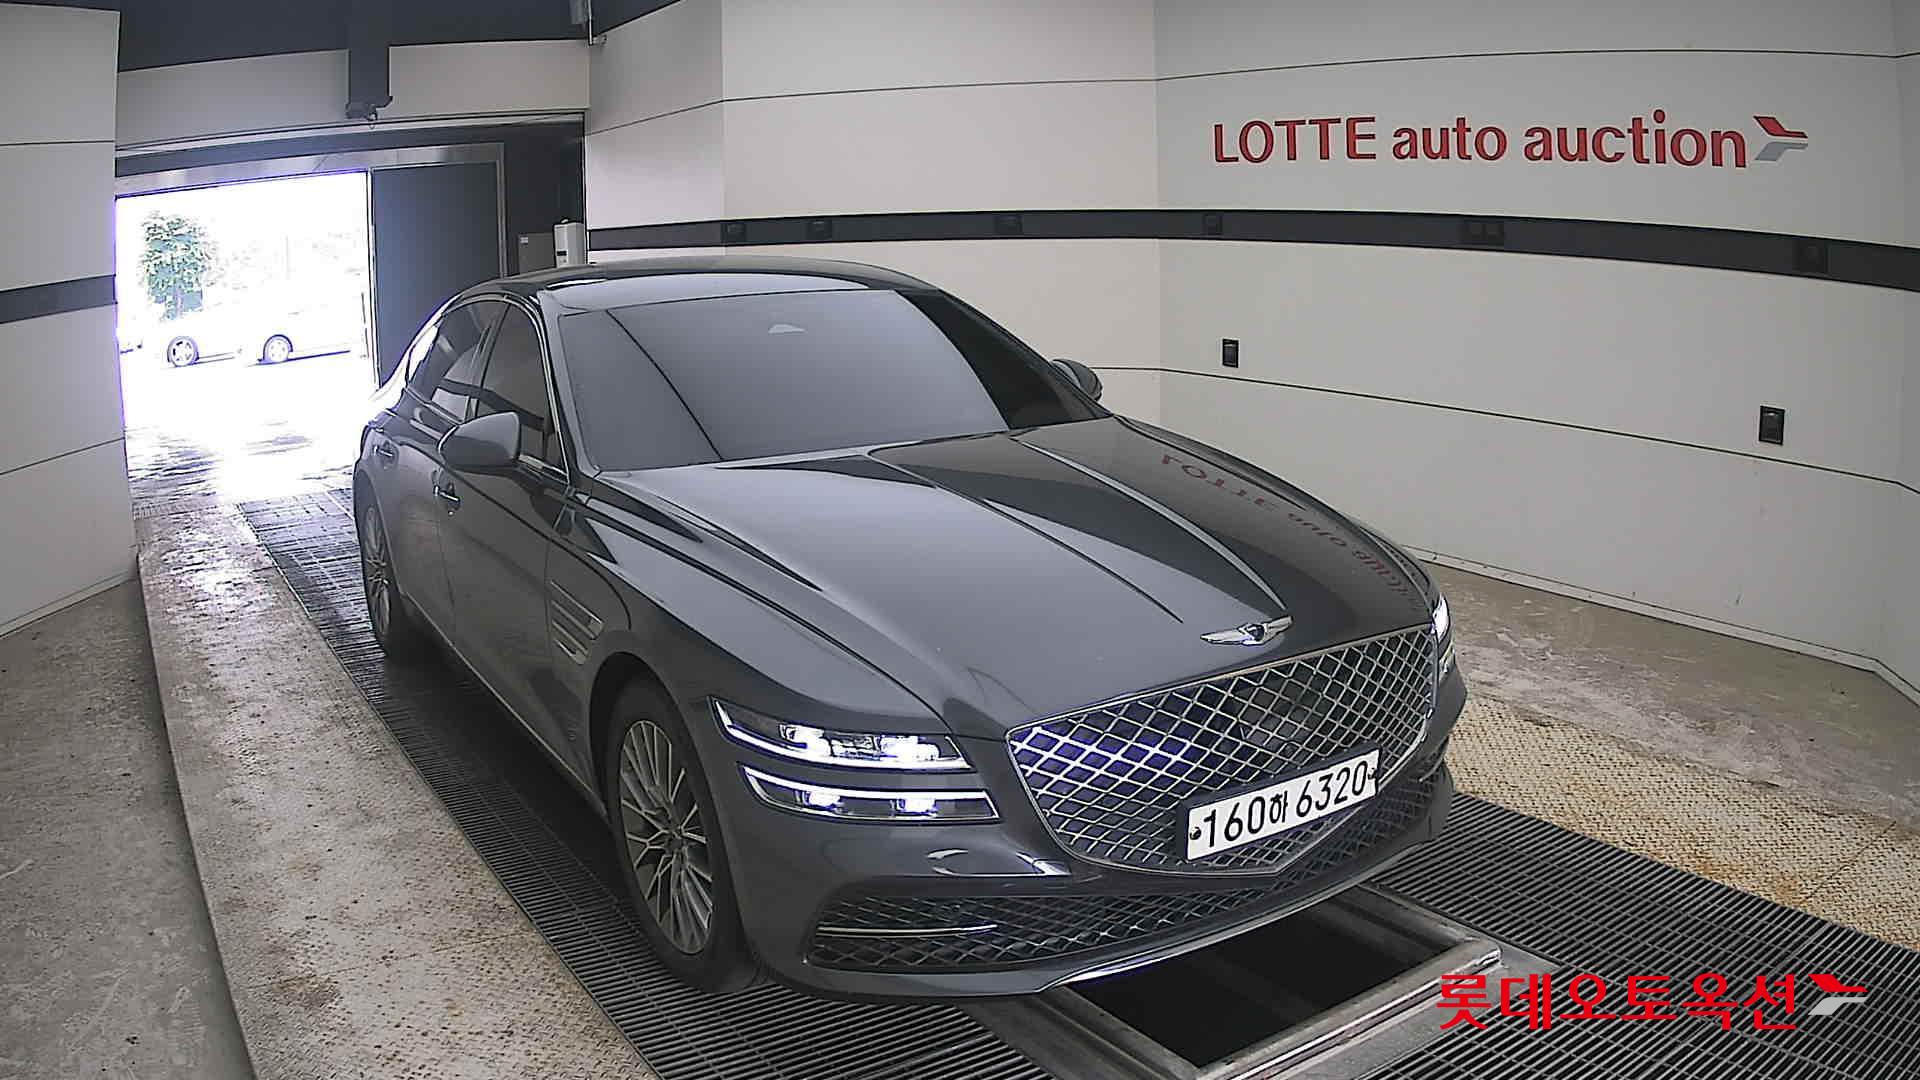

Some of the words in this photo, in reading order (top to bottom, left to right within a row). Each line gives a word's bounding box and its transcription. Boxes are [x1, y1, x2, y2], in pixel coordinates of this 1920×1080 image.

[1213, 116, 1376, 163] LOTTE
[1392, 117, 1507, 161] auto
[1523, 109, 1747, 168] auction
